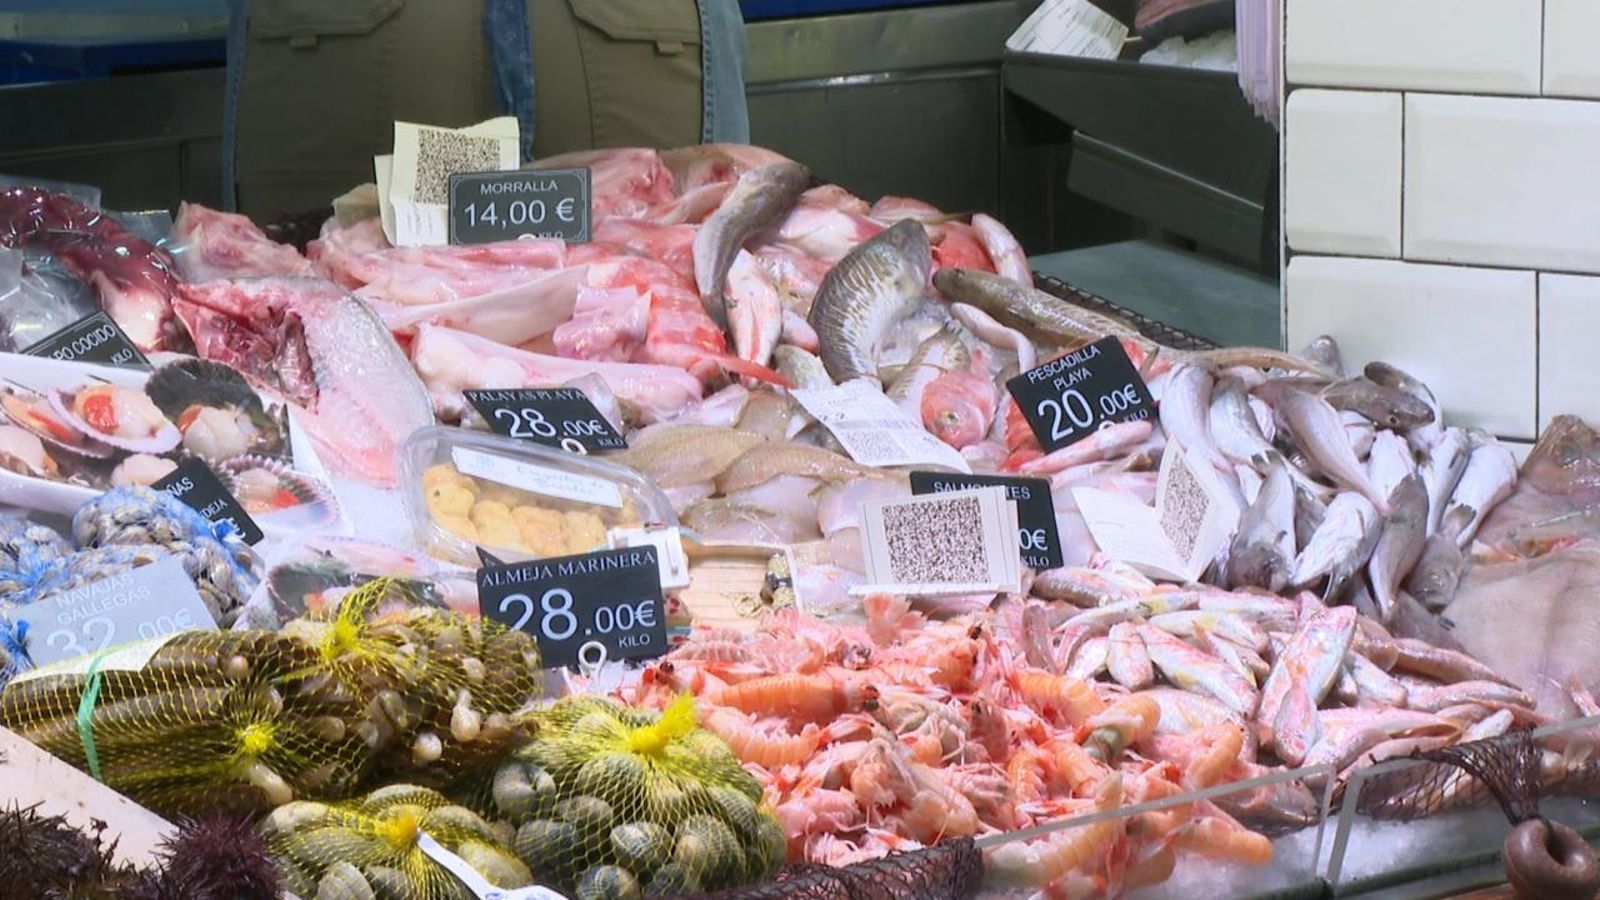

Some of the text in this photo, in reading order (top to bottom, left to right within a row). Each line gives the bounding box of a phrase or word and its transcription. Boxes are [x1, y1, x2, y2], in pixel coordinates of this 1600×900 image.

[480, 180, 558, 195] MORRALLA
[464, 199, 546, 229] 14,00
[555, 197, 575, 221] €
[72, 324, 116, 355] COCIDO
[111, 348, 133, 366] KILO
[1028, 345, 1101, 384] PESCADILLA
[1053, 367, 1092, 391] PLAYA
[482, 551, 655, 587] ALMEJA MARINERA
[56, 572, 135, 608] NAVAJAS
[57, 585, 150, 625] GALLEGAS
[618, 633, 650, 648] KILO
